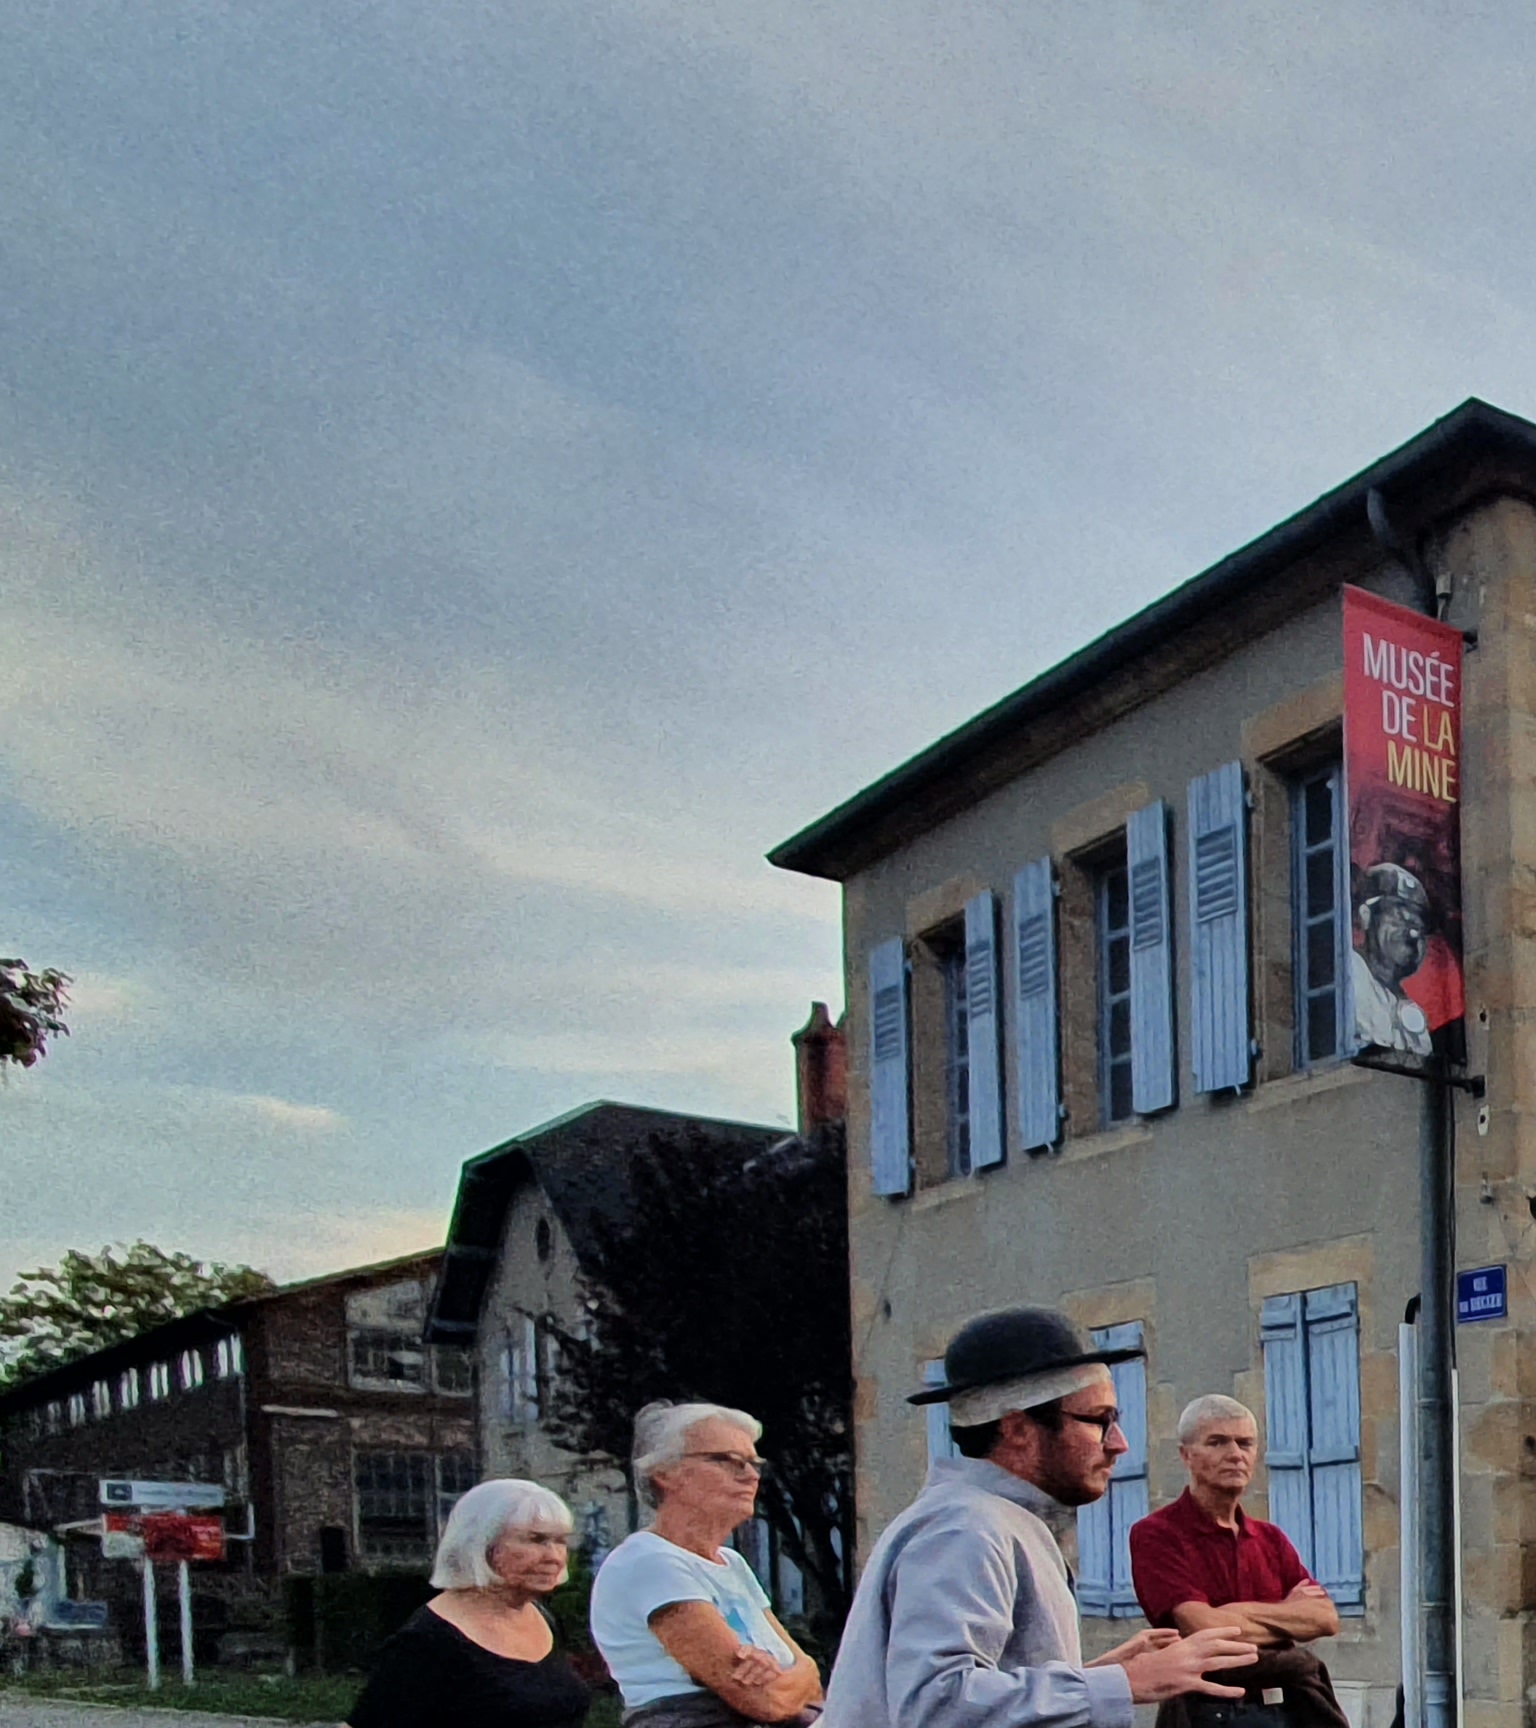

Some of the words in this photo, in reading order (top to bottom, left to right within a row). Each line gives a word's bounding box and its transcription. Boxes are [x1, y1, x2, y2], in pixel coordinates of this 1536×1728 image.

[1363, 632, 1455, 708] MUSÉE
[1382, 689, 1418, 743] DE
[1422, 704, 1456, 757] LA
[1387, 739, 1458, 803] MINE
